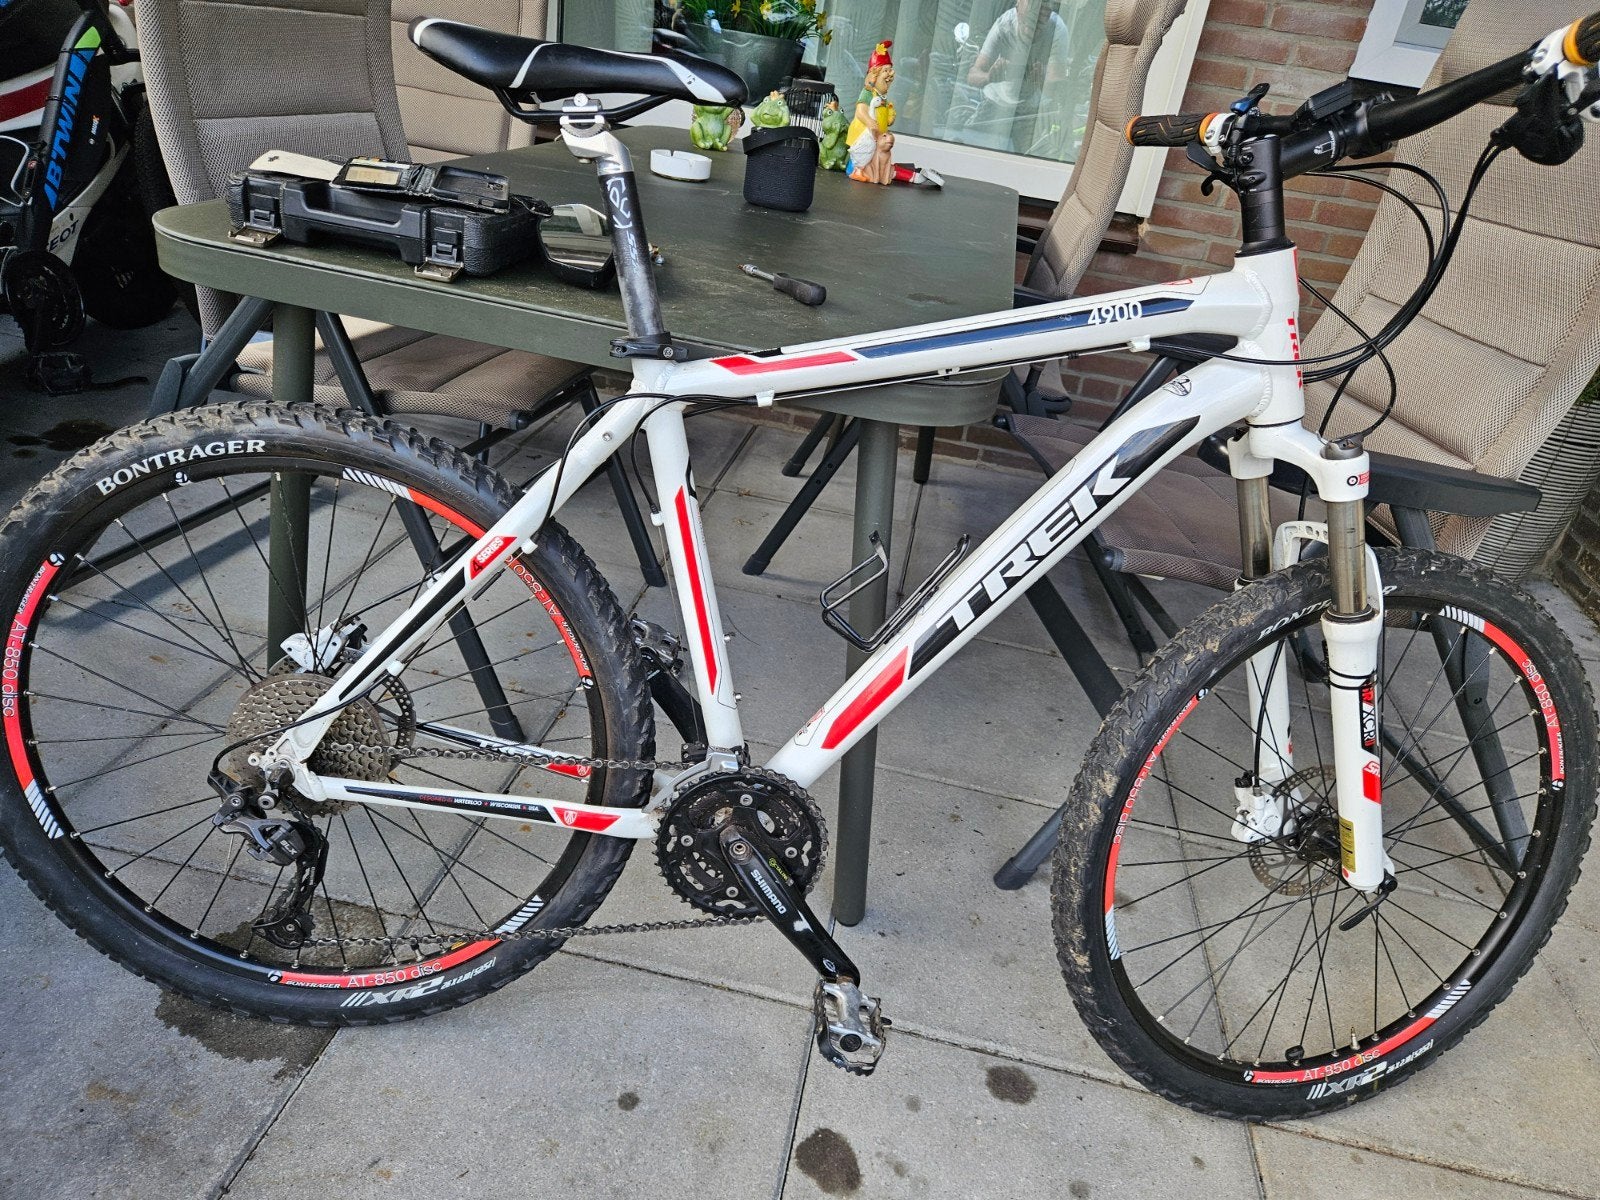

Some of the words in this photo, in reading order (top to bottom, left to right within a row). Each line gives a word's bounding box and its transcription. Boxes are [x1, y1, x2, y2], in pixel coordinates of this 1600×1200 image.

[1087, 300, 1143, 326] 4900
[95, 439, 266, 496] BONTRAGER
[475, 535, 504, 564] SERIES
[936, 453, 1132, 631] TREK
[16, 565, 46, 615] BONTRAGER
[513, 564, 562, 616] AT-850
[2, 618, 28, 680] AT-850
[1, 683, 19, 718] disc
[1521, 658, 1542, 682] disc
[1534, 683, 1560, 728] AT-850
[453, 798, 483, 806] WATERLOO
[1113, 812, 1133, 844] disc
[750, 869, 787, 915] SHIMANO
[284, 979, 342, 989] BONTRAGER
[346, 969, 408, 988] AT-850
[411, 961, 443, 980] disc
[1302, 1059, 1351, 1082] AT-850
[1353, 1049, 1382, 1066] disc
